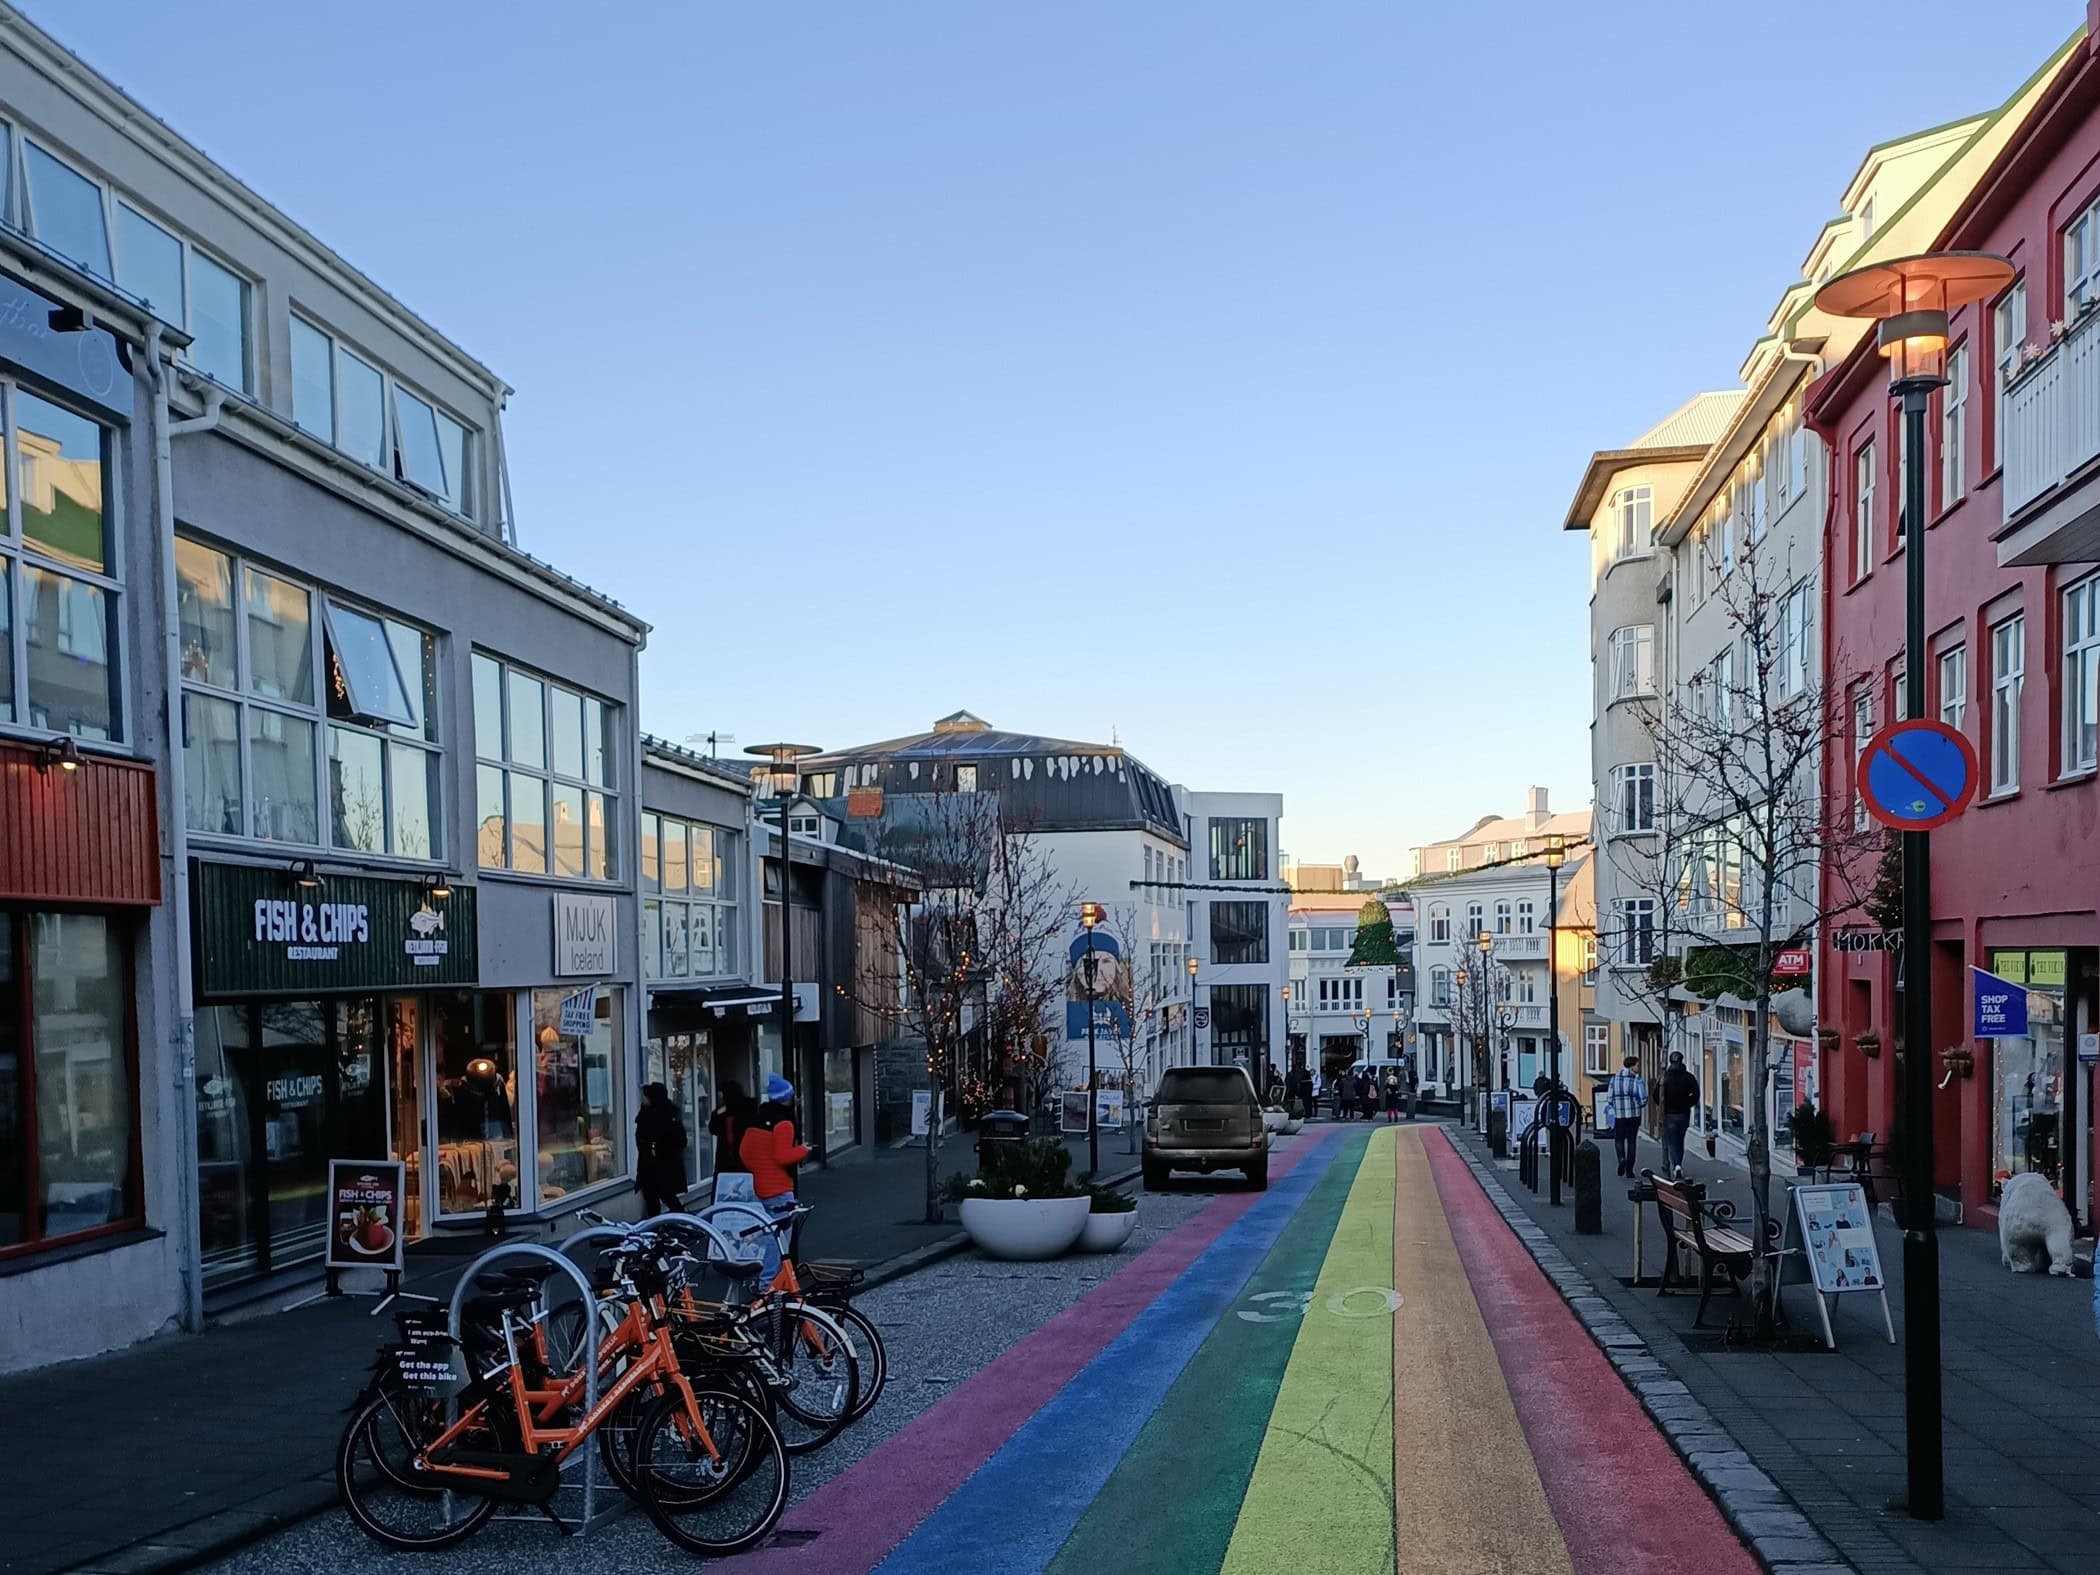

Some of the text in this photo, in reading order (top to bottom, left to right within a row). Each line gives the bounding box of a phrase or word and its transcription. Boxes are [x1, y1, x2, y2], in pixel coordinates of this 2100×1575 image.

[255, 899, 369, 943] FISH & CHIPS
[566, 899, 606, 942] MJÚK
[287, 946, 338, 960] RESTAURANT
[571, 947, 603, 971] Iceland
[1778, 954, 1803, 966] ATM
[1981, 995, 2008, 1004] SHOP
[1981, 1005, 2001, 1013] TAX
[575, 1011, 590, 1020] FREE
[1981, 1014, 2006, 1023] FREE
[563, 1019, 591, 1028] SHOPPING
[267, 1080, 288, 1101] FISH
[289, 1080, 296, 1096] &
[297, 1075, 323, 1098] CHIPS
[339, 1189, 358, 1200] FISH
[365, 1190, 392, 1200] CHIPS
[400, 1361, 449, 1371] Get the app
[403, 1371, 457, 1381] Get this bike
